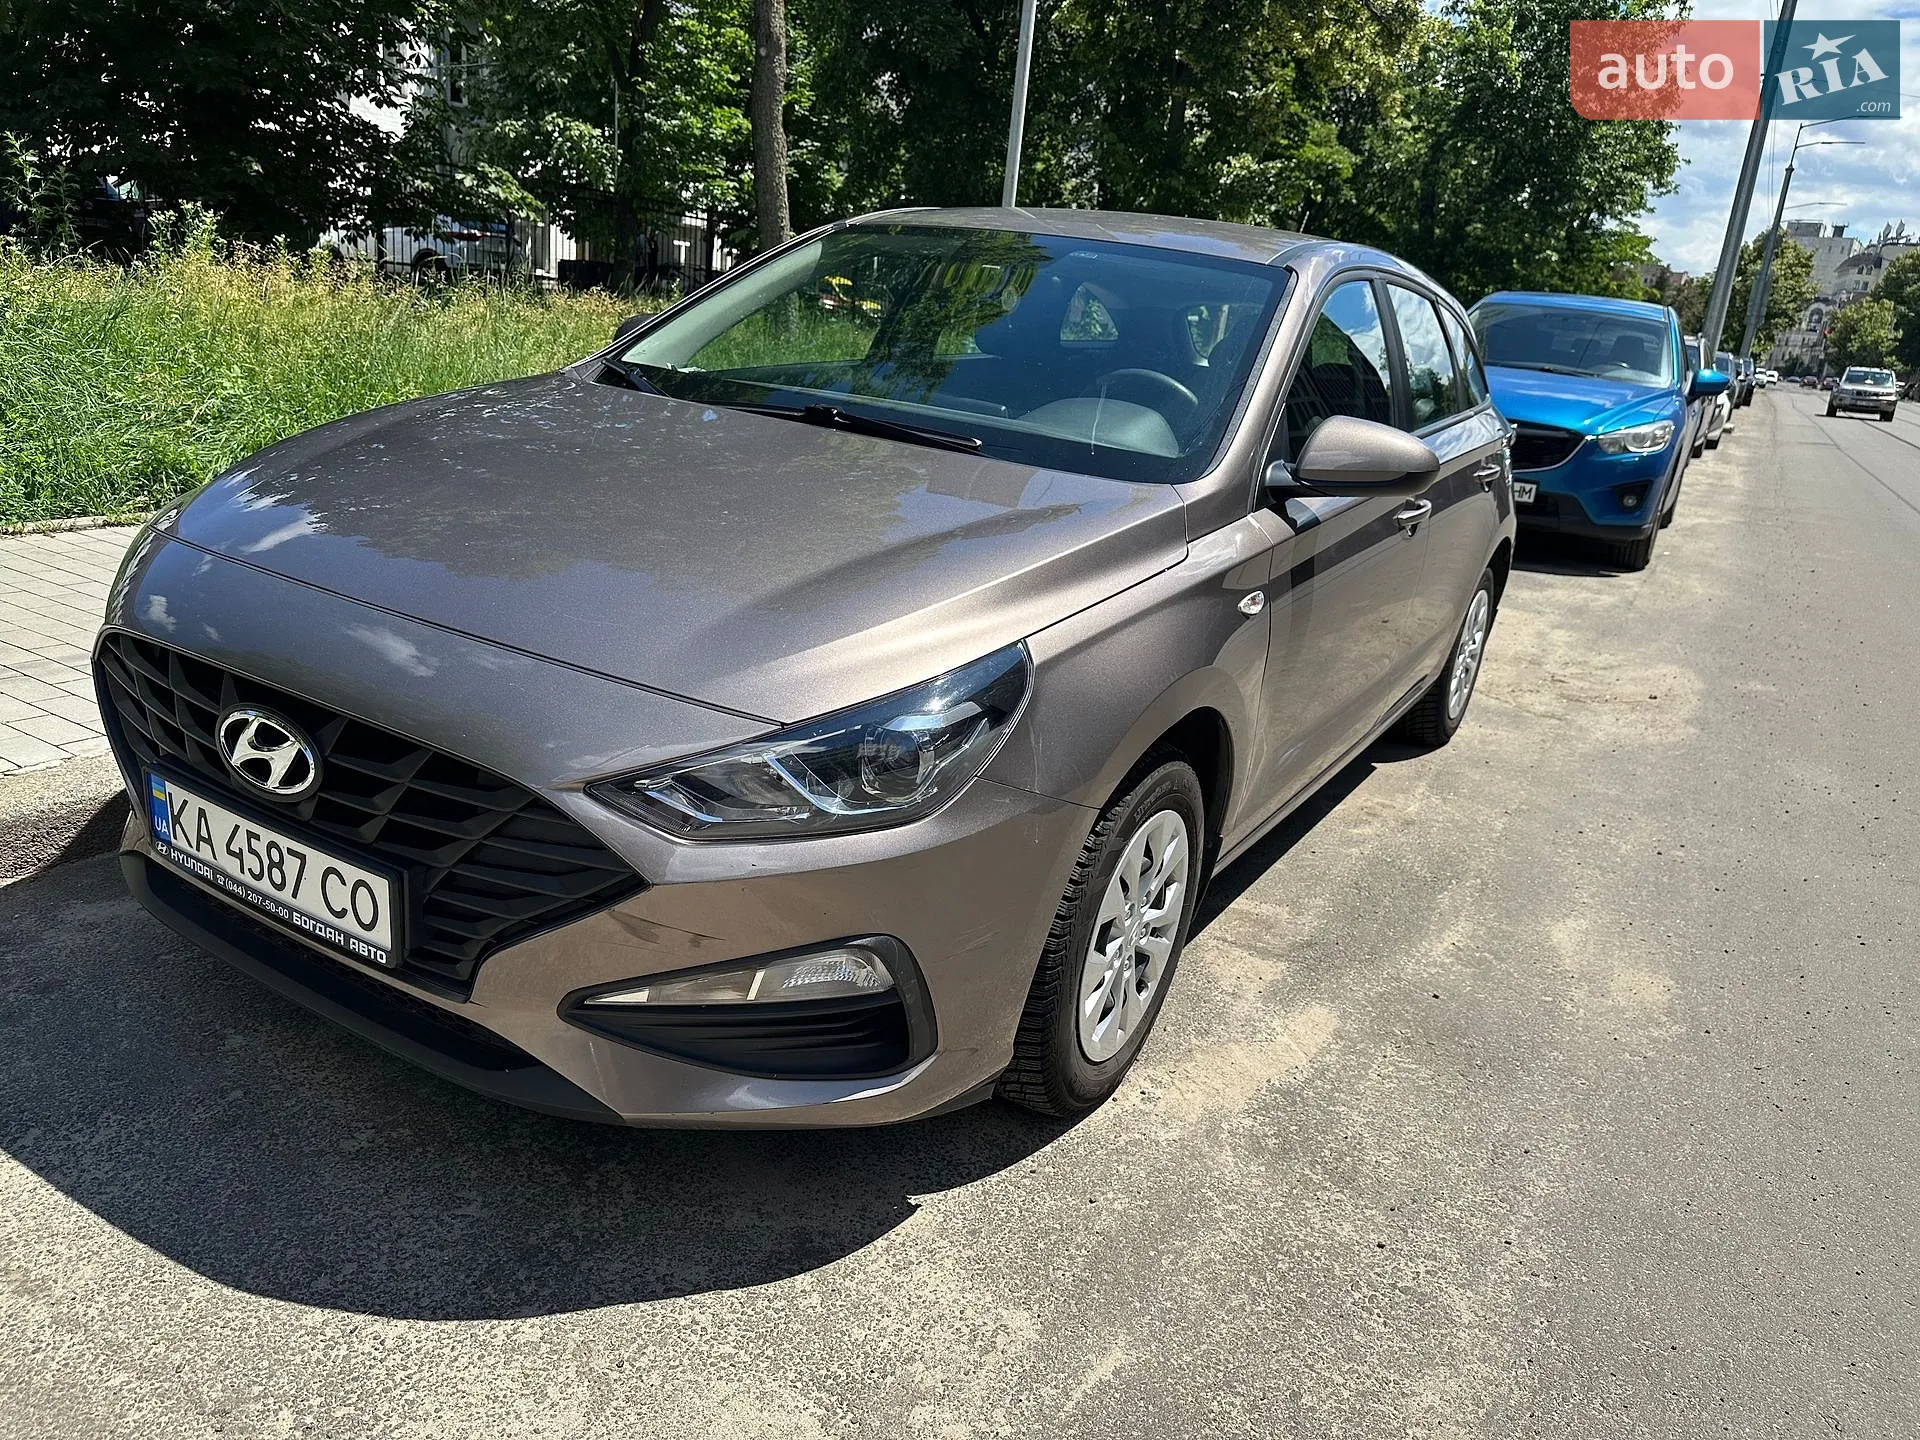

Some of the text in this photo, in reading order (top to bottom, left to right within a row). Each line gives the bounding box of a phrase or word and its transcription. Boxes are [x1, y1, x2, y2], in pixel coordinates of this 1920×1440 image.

[154, 815, 169, 836] UA
[167, 791, 379, 932] KA 4587 CO
[170, 848, 387, 964] HYUNDAI (044) 207-50-00 БОГДАН АВТО
